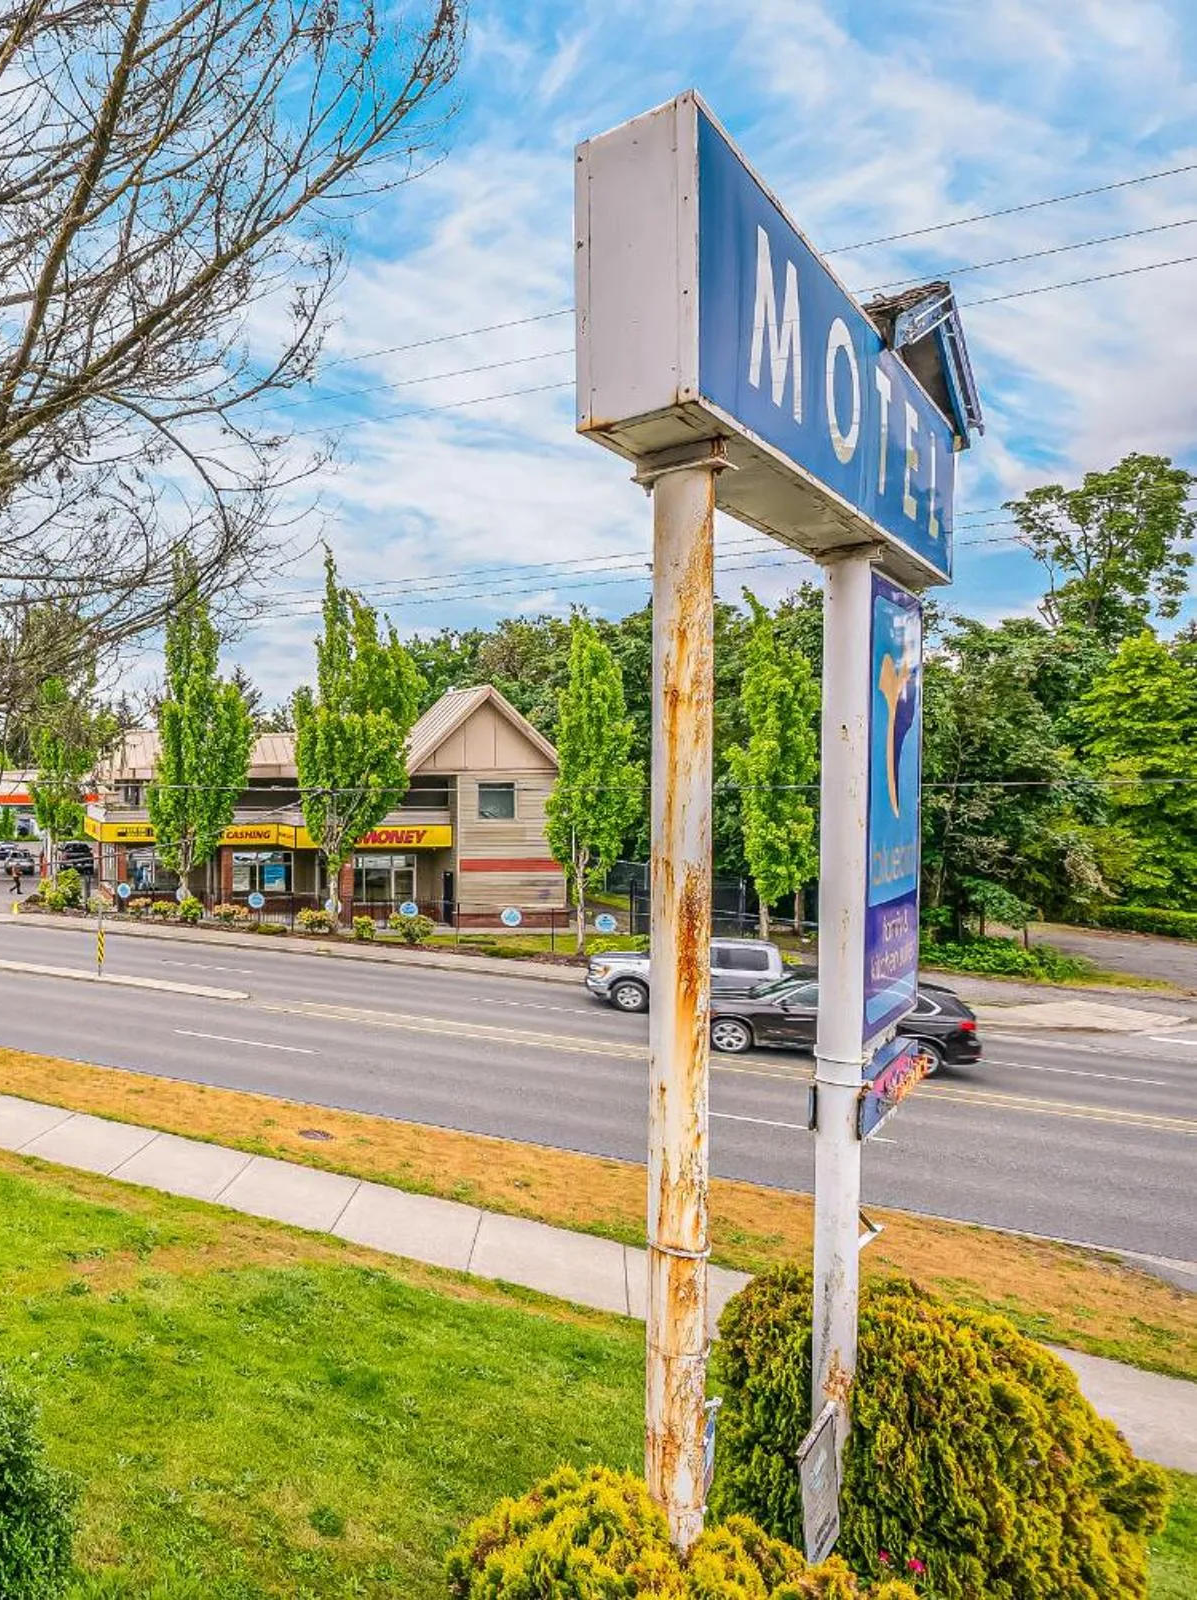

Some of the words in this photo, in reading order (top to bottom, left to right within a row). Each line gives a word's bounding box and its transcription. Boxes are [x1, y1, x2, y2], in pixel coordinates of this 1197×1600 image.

[748, 224, 940, 539] MOTEL
[225, 830, 271, 840] CASHING
[361, 829, 427, 845] MONEY
